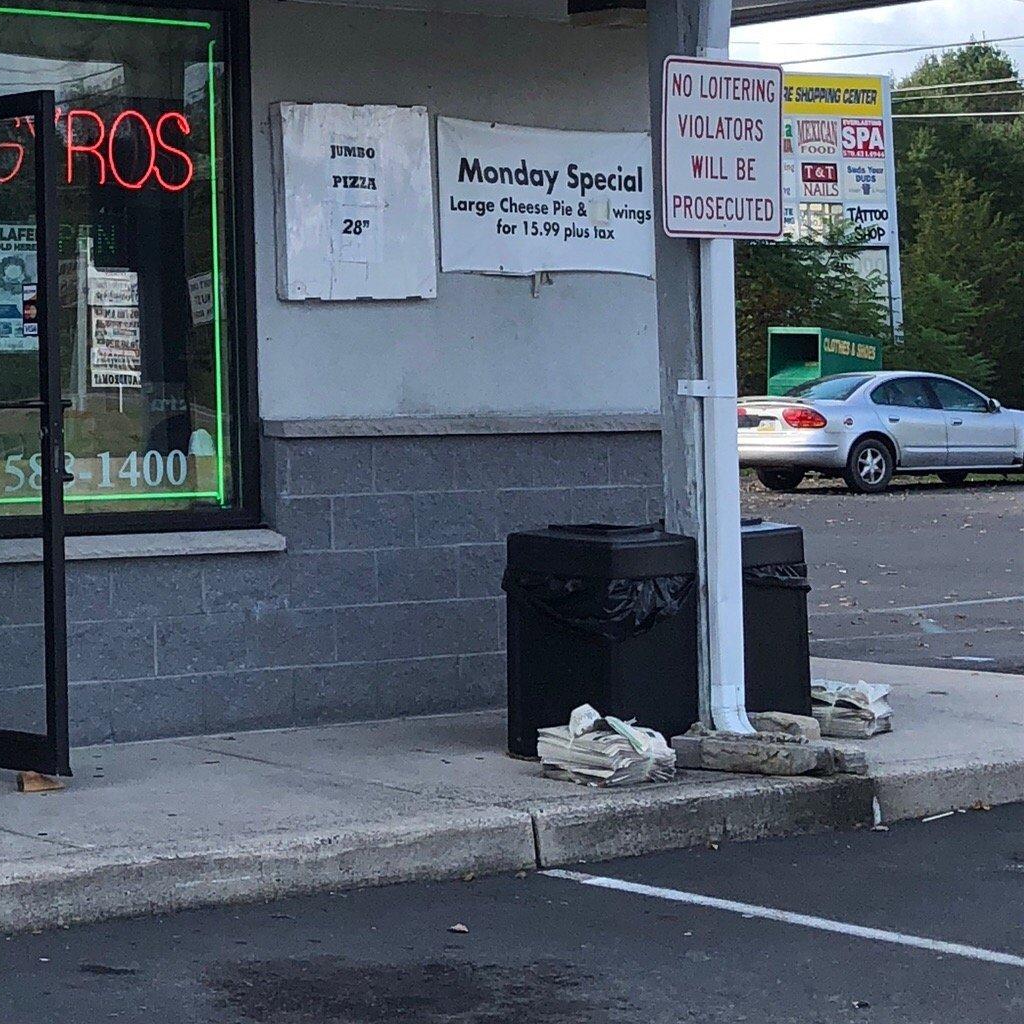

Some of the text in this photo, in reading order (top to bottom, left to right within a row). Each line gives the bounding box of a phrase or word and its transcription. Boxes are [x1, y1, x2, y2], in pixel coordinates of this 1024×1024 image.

[672, 72, 775, 103] NO LOITERING
[795, 86, 841, 104] SHOPPING
[842, 88, 877, 106] CENTER
[678, 114, 764, 141] VIOLATORS
[797, 120, 837, 147] MEXICAN
[842, 126, 885, 150] SPA
[330, 144, 376, 159] JUMBO
[801, 145, 836, 154] FOOD
[457, 157, 643, 196] Monday Special
[691, 155, 728, 180] WILL
[736, 158, 756, 181] BE
[332, 175, 377, 190] PIZZA
[804, 183, 839, 196] NAILS
[450, 196, 652, 224] Large Cheese Pie & wings
[673, 195, 774, 221] PROSECUTED
[846, 206, 889, 223] TATTOO
[496, 218, 615, 241] for 15.99 plus tax
[855, 224, 885, 241] SHOP
